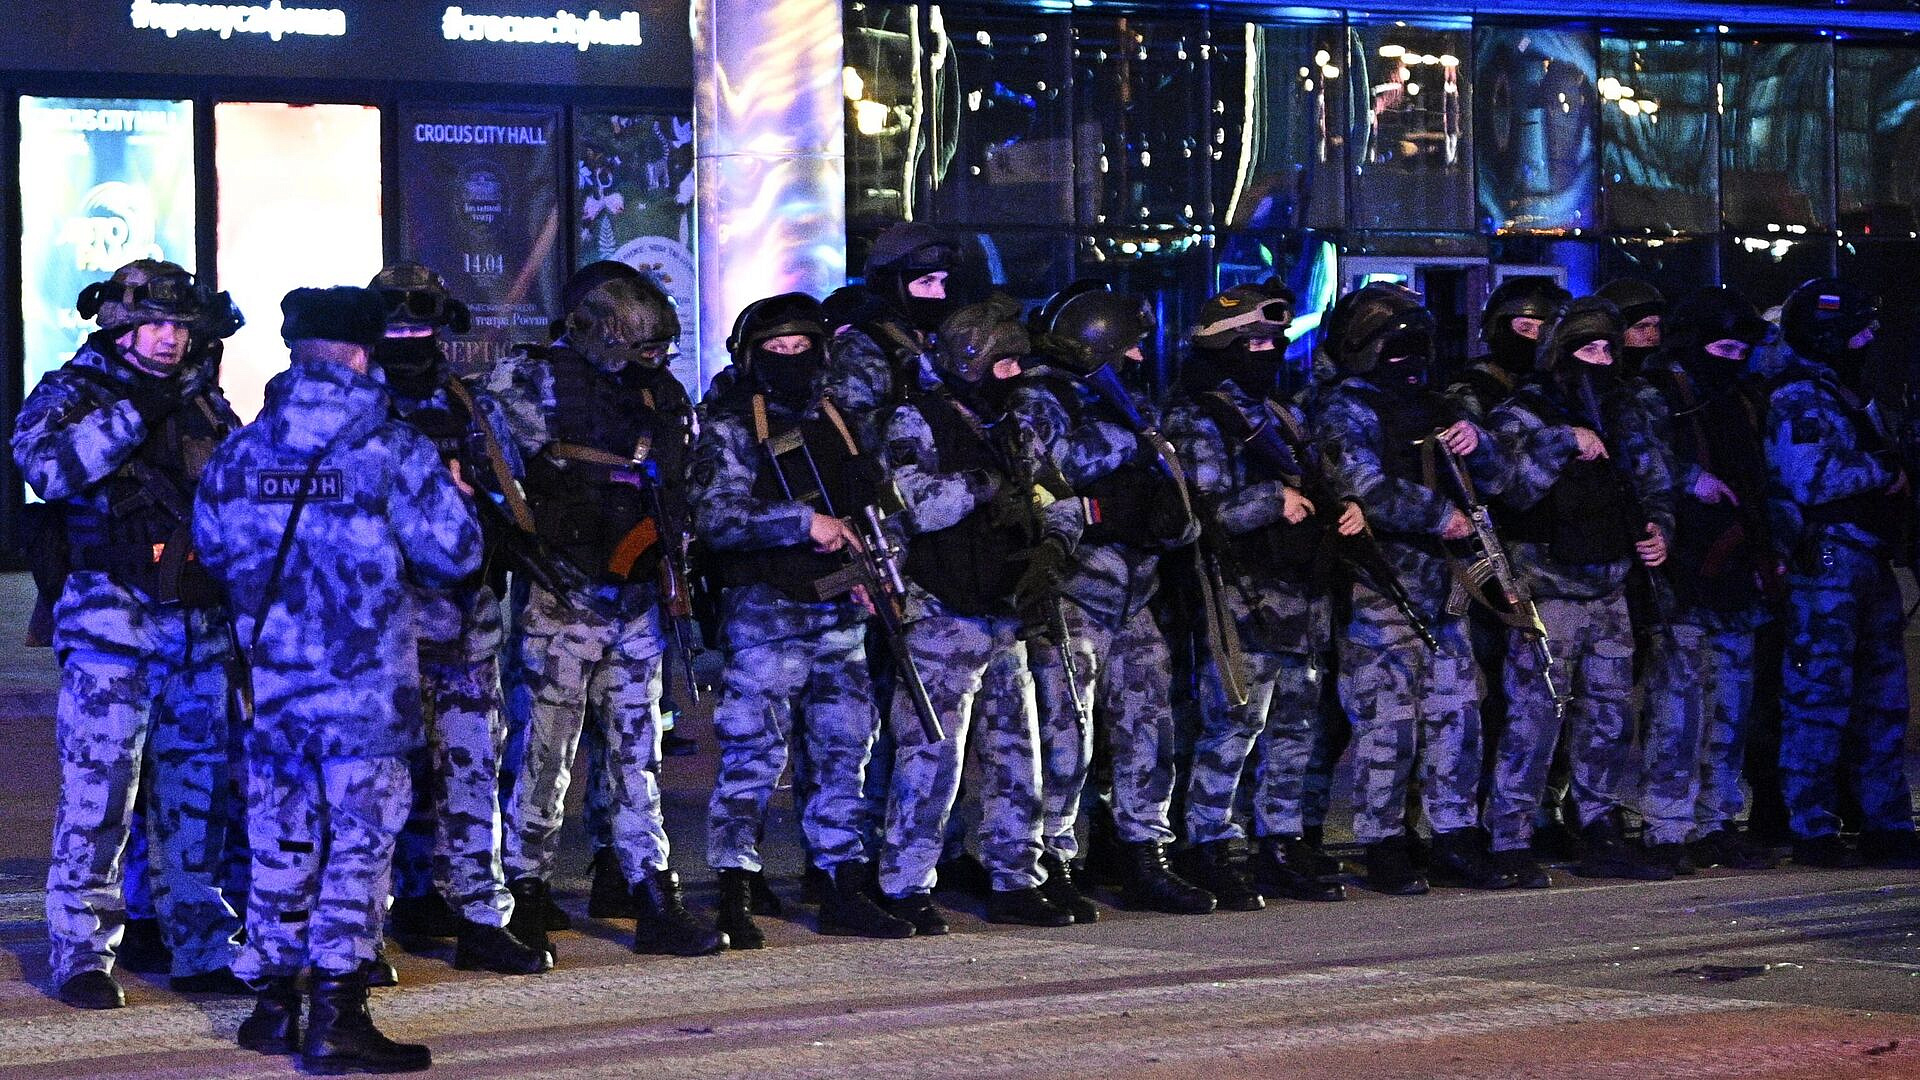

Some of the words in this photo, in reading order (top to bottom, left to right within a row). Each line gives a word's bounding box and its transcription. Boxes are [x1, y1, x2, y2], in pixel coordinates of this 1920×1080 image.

[415, 123, 473, 143] CROCUS
[474, 125, 506, 144] CITY
[507, 126, 547, 145] HALL
[463, 253, 504, 276] 14.04
